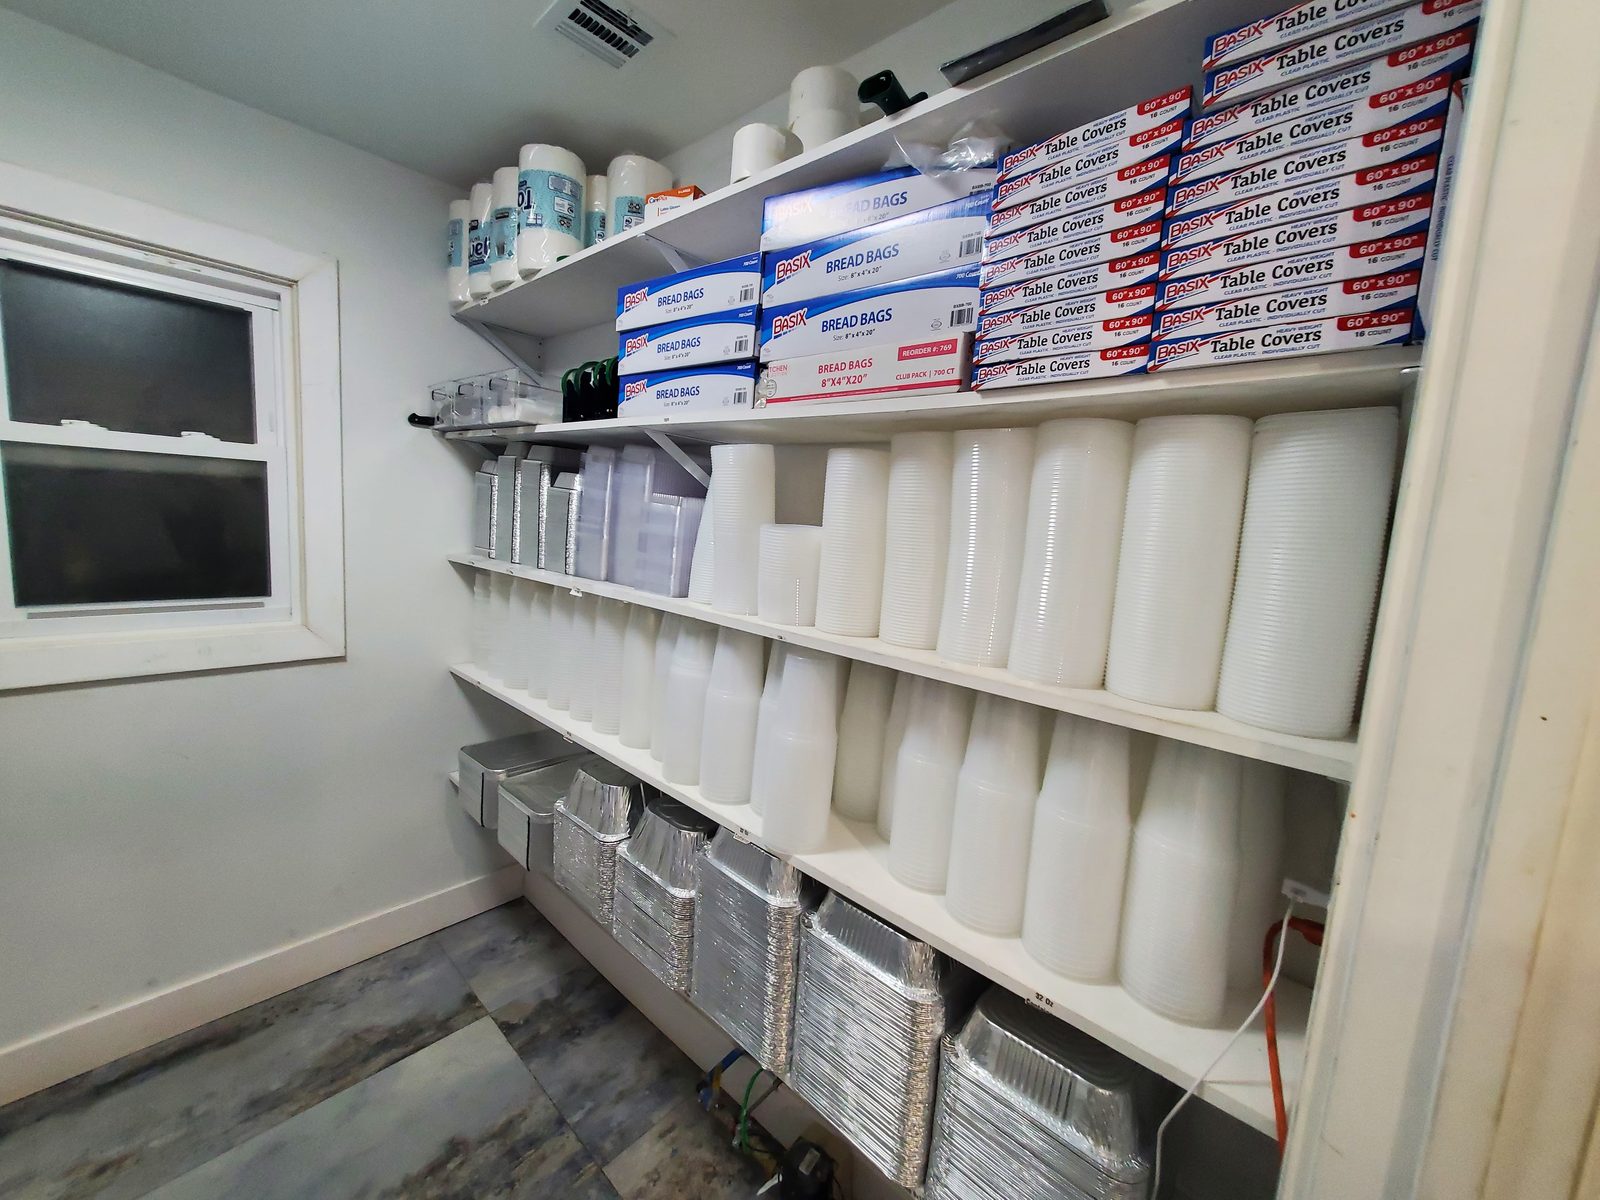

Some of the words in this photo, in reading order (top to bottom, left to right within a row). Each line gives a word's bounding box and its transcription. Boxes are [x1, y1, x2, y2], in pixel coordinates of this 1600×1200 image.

[1276, 6, 1327, 32] Table
[1214, 21, 1264, 54] BASIX
[1276, 45, 1327, 70] Table
[1334, 20, 1404, 51] Covers
[1215, 60, 1264, 90] BASIX
[1251, 94, 1298, 118] Table
[1305, 71, 1371, 100] Covers
[1388, 104, 1399, 112] 16
[1401, 97, 1429, 109] COUNT
[1159, 106, 1178, 116] COUNT
[1193, 108, 1240, 136] BASIX
[1236, 132, 1283, 154] Table
[1289, 111, 1353, 139] Covers
[1044, 136, 1078, 155] Table
[1082, 118, 1127, 141] Covers
[1380, 144, 1391, 153] 16
[1392, 138, 1420, 150] COUNT
[1004, 147, 1037, 169] BASIX
[1038, 166, 1071, 184] Table
[1075, 149, 1119, 171] Covers
[1180, 144, 1225, 171] BASIX
[1231, 168, 1277, 189] Table
[1283, 150, 1346, 176] Covers
[999, 175, 1031, 196] BASIX
[1176, 178, 1221, 205] BASIX
[873, 191, 908, 210] BAGS
[1029, 197, 1061, 214] Table
[1065, 183, 1107, 203] Covers
[1225, 204, 1271, 224] Table
[1277, 188, 1340, 212] Covers
[991, 206, 1021, 226] BASIX
[1134, 206, 1152, 215] COUNT
[1026, 226, 1058, 243] Table
[1062, 213, 1104, 233] Covers
[1170, 213, 1214, 238] BASIX
[1371, 220, 1382, 228] 16
[1384, 215, 1410, 225] COUNT
[989, 233, 1020, 253] BASIX
[1223, 236, 1269, 256] Table
[1275, 222, 1337, 245] Covers
[777, 253, 812, 279] BASIX
[826, 253, 864, 274] BREAD
[866, 242, 899, 264] BAGS
[1023, 253, 1055, 270] Table
[1059, 243, 1100, 261] Covers
[1168, 244, 1212, 267] BASIX
[986, 260, 1016, 278] BASIX
[1220, 270, 1265, 288] Table
[1272, 258, 1334, 279] Covers
[1022, 282, 1053, 297] Table
[1057, 273, 1099, 290] Covers
[1166, 277, 1209, 298] BASIX
[1373, 290, 1398, 299] COUNT
[625, 289, 648, 308] BASIX
[657, 293, 682, 307] BREAD
[684, 288, 704, 301] BAGS
[985, 287, 1015, 305] BASIX
[1020, 309, 1051, 324] Table
[1054, 303, 1096, 319] Covers
[1215, 303, 1260, 321] Table
[1266, 293, 1328, 313] Covers
[774, 310, 807, 335] BASIX
[821, 315, 858, 333] BREAD
[860, 307, 893, 326] BAGS
[983, 313, 1013, 331] BASIX
[1161, 308, 1205, 329] BASIX
[1017, 336, 1048, 349] Table
[1052, 330, 1093, 345] Covers
[1210, 337, 1255, 353] Table
[1261, 330, 1322, 347] Covers
[1367, 328, 1392, 336] COUNT
[626, 335, 648, 353] BASIX
[657, 340, 680, 354] BREAD
[681, 336, 701, 348] BAGS
[902, 348, 932, 357] REORDER
[980, 338, 1010, 355] BASIX
[1157, 340, 1200, 360] BASIX
[818, 362, 846, 374] BREAD
[848, 358, 873, 370] BAGS
[911, 371, 927, 379] PACK
[946, 367, 955, 375] CT
[978, 365, 1008, 380] BASIX
[1015, 363, 1046, 376] Table
[1050, 359, 1090, 372] Covers
[625, 381, 647, 397] BASIX
[656, 388, 679, 400] BREAD
[680, 386, 700, 397] BAGS
[1035, 992, 1043, 1002] 32
